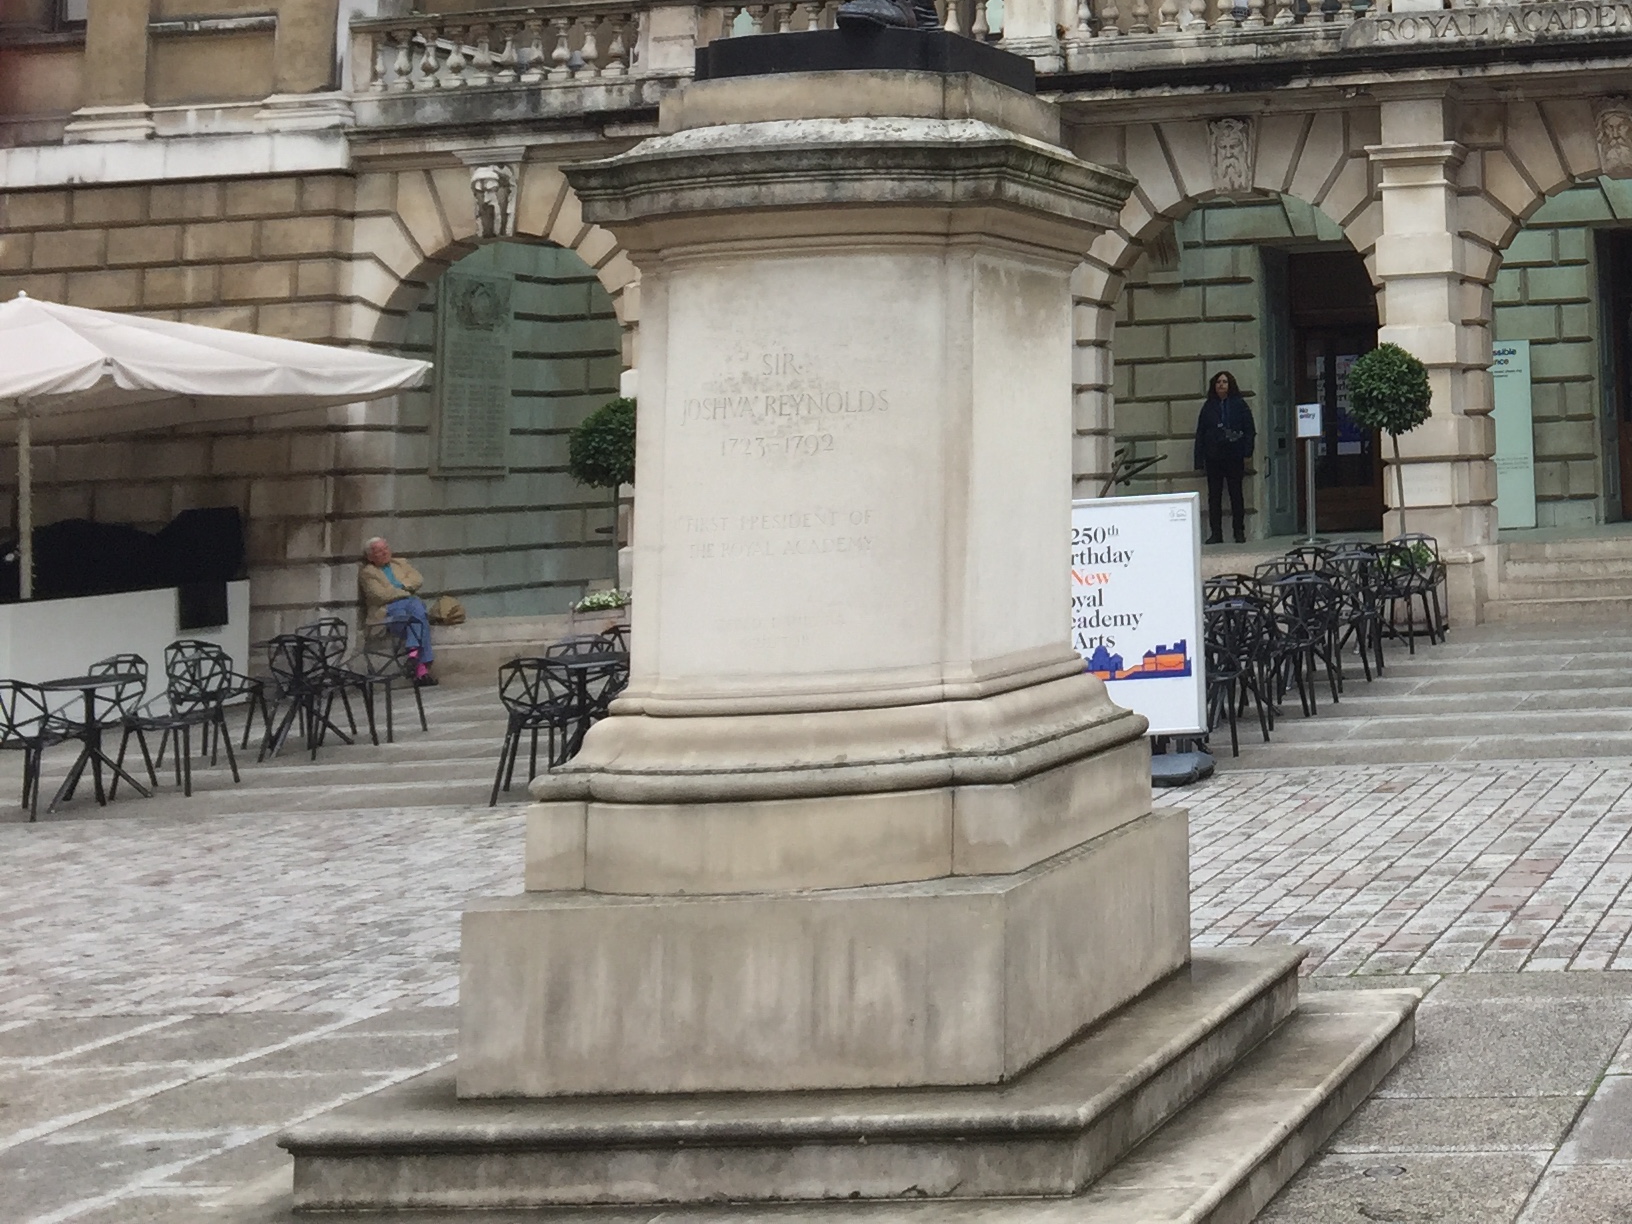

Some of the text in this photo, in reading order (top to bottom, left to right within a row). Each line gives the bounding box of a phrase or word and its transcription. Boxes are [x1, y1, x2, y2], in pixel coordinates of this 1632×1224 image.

[764, 389, 890, 417] REYNOLDS
[1071, 568, 1112, 586] New
[1073, 632, 1116, 650] Arts
